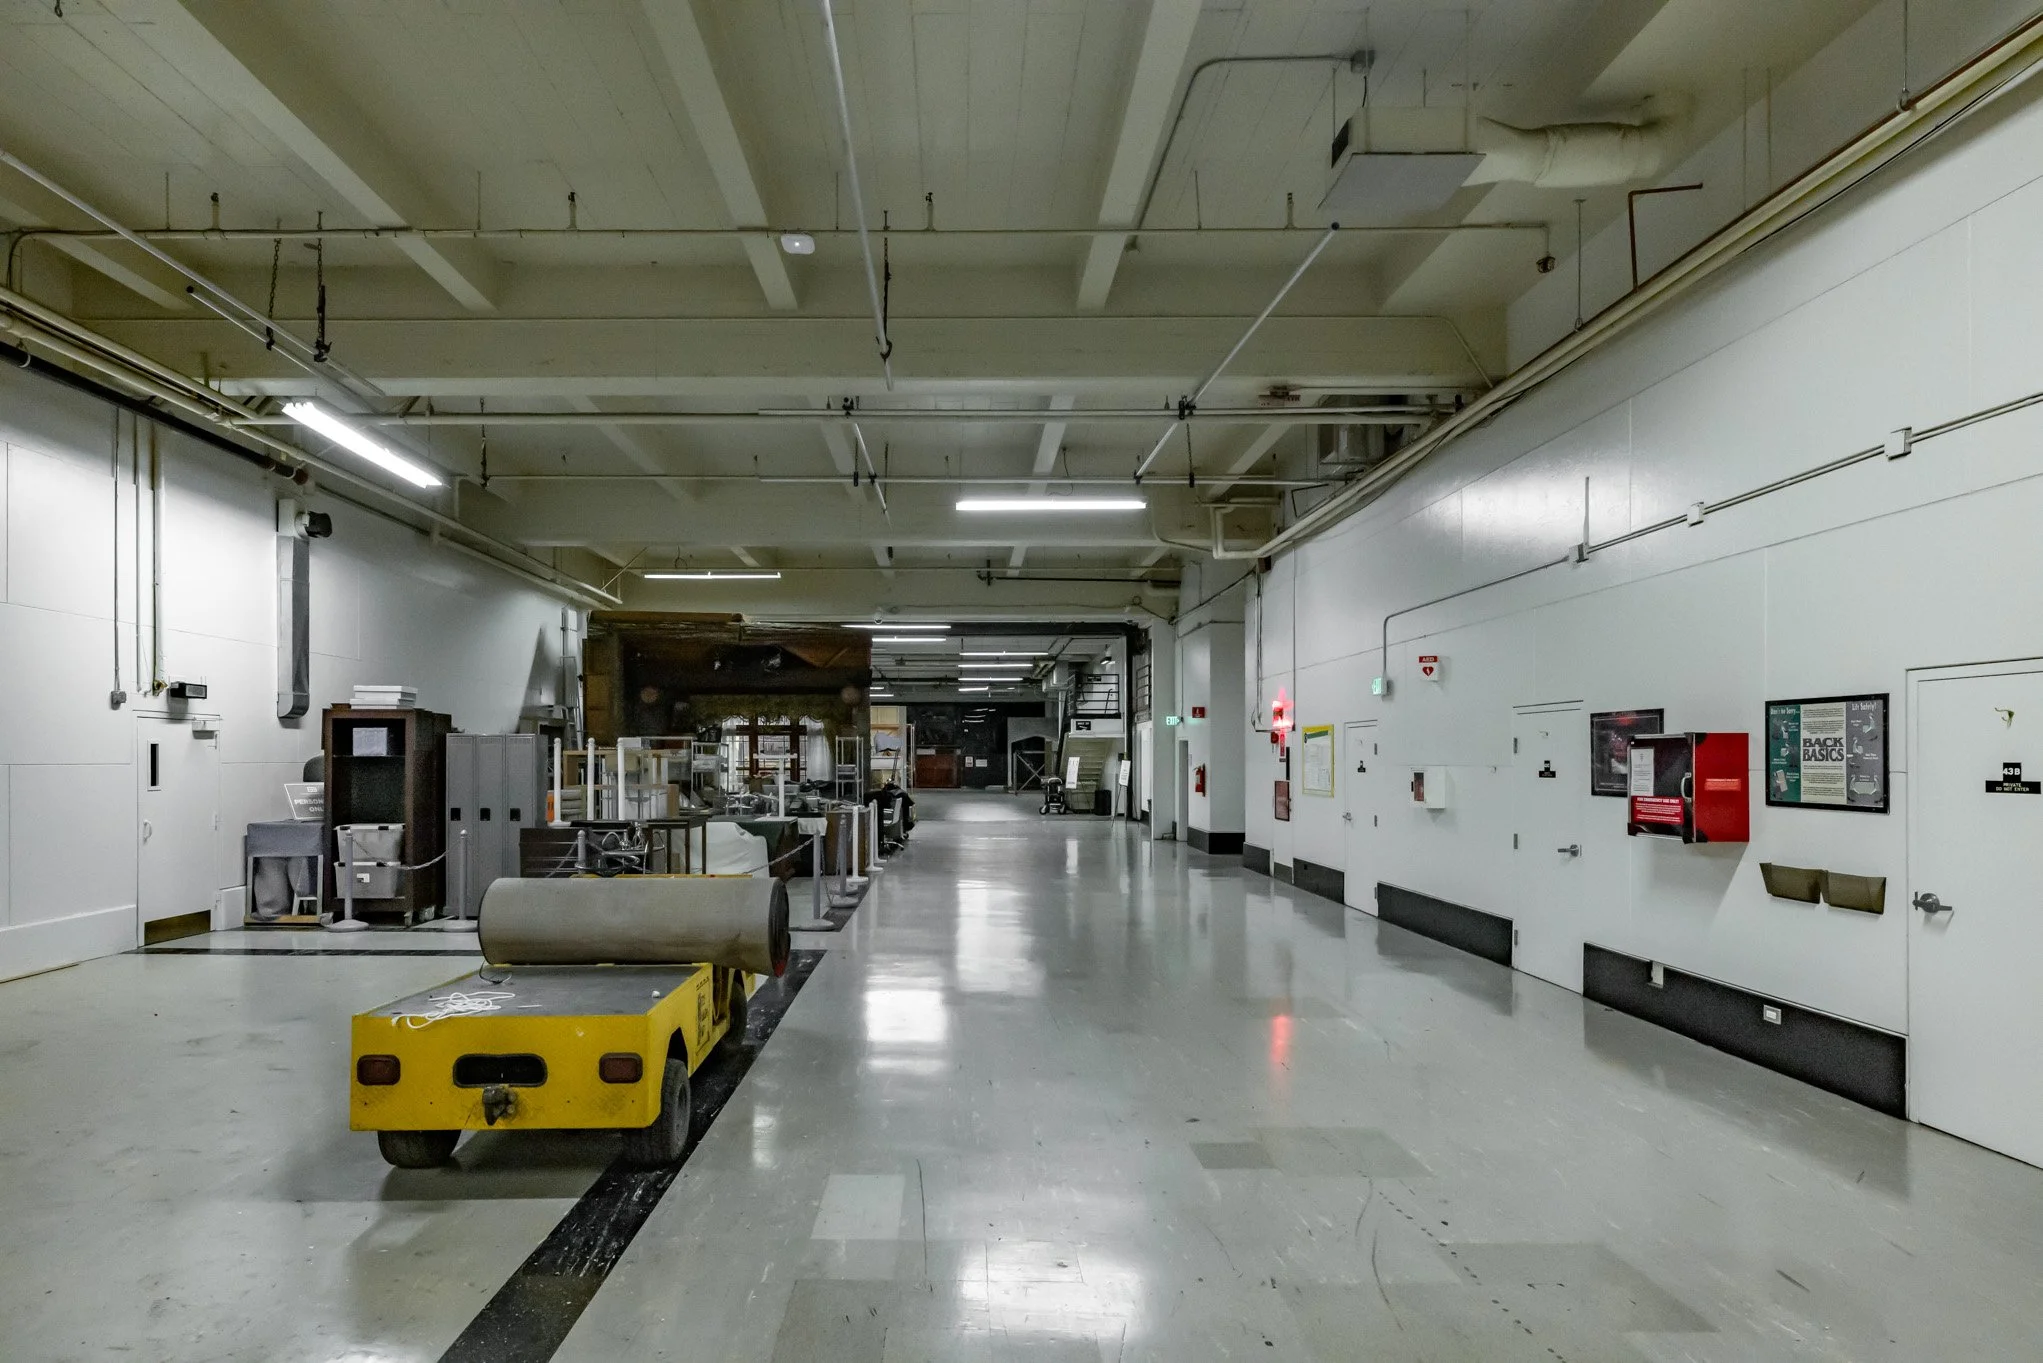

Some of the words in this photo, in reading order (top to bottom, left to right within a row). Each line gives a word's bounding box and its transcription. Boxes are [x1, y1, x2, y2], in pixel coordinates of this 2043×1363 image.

[1803, 737, 1844, 748] BACK
[1803, 746, 1845, 762] BASICS
[2003, 767, 2021, 775] 43B
